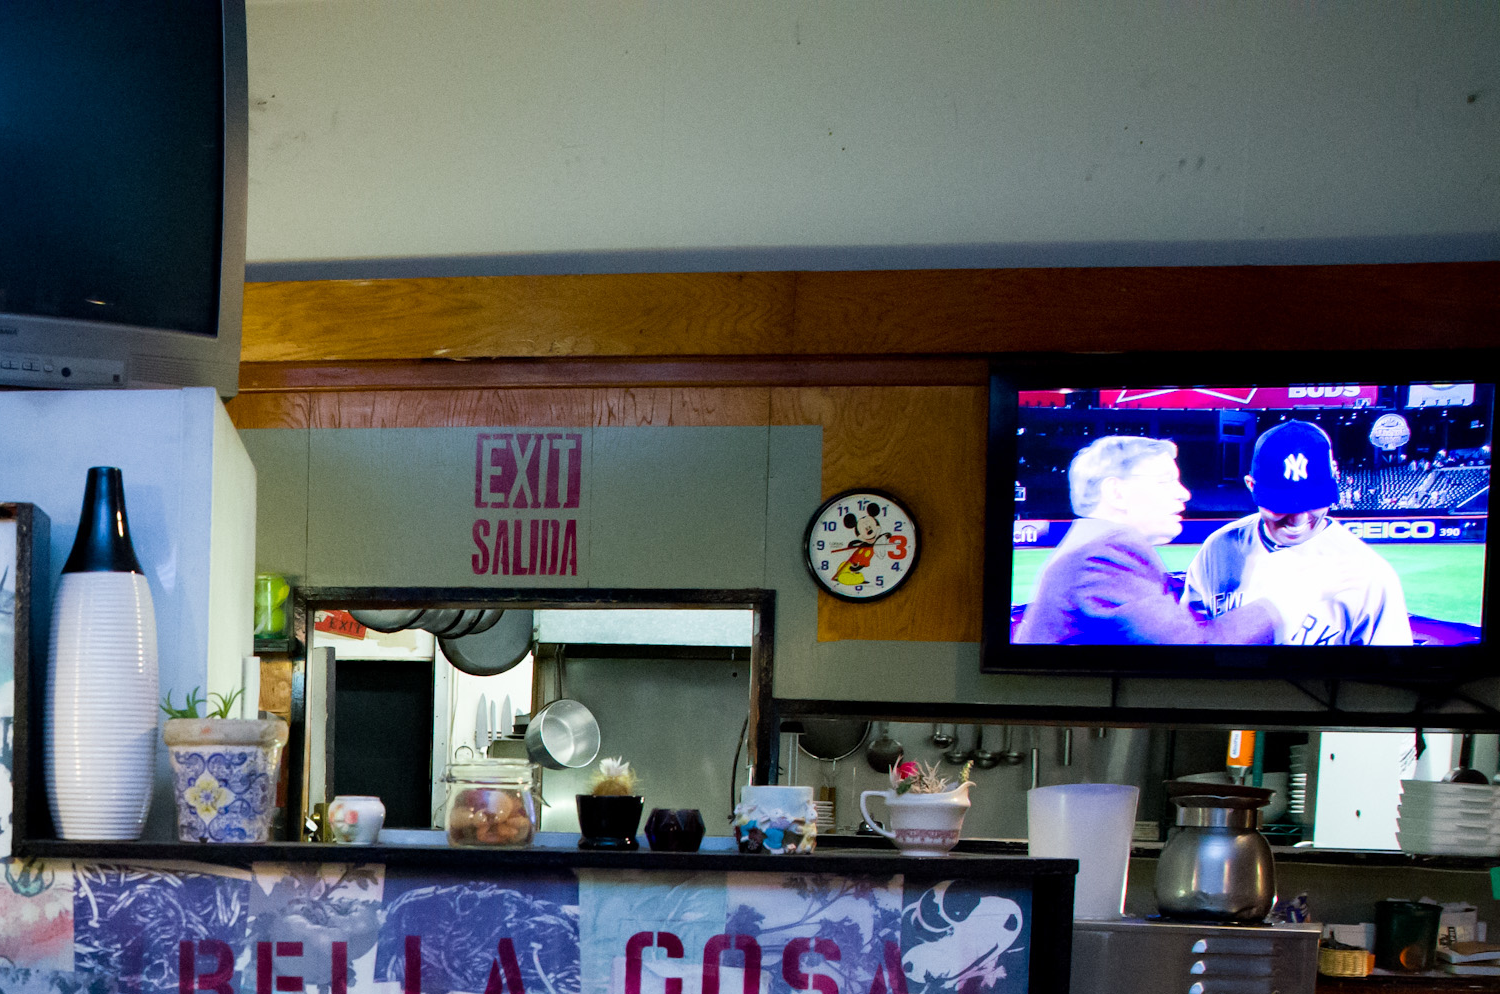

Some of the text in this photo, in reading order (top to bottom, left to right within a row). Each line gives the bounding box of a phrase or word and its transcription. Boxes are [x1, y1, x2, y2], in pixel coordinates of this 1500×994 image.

[1288, 386, 1361, 399] BUDS
[478, 433, 580, 508] EXIT
[822, 521, 837, 532] 10
[893, 521, 903, 532] 2
[1343, 520, 1461, 539] GEICO 390
[1012, 525, 1038, 543] citi
[471, 518, 578, 576] SALIDA
[816, 540, 825, 551] 9
[887, 535, 907, 560] 3
[820, 560, 829, 571] 8
[890, 562, 901, 572] 4
[875, 576, 884, 587] 5
[329, 616, 361, 635] EXIT
